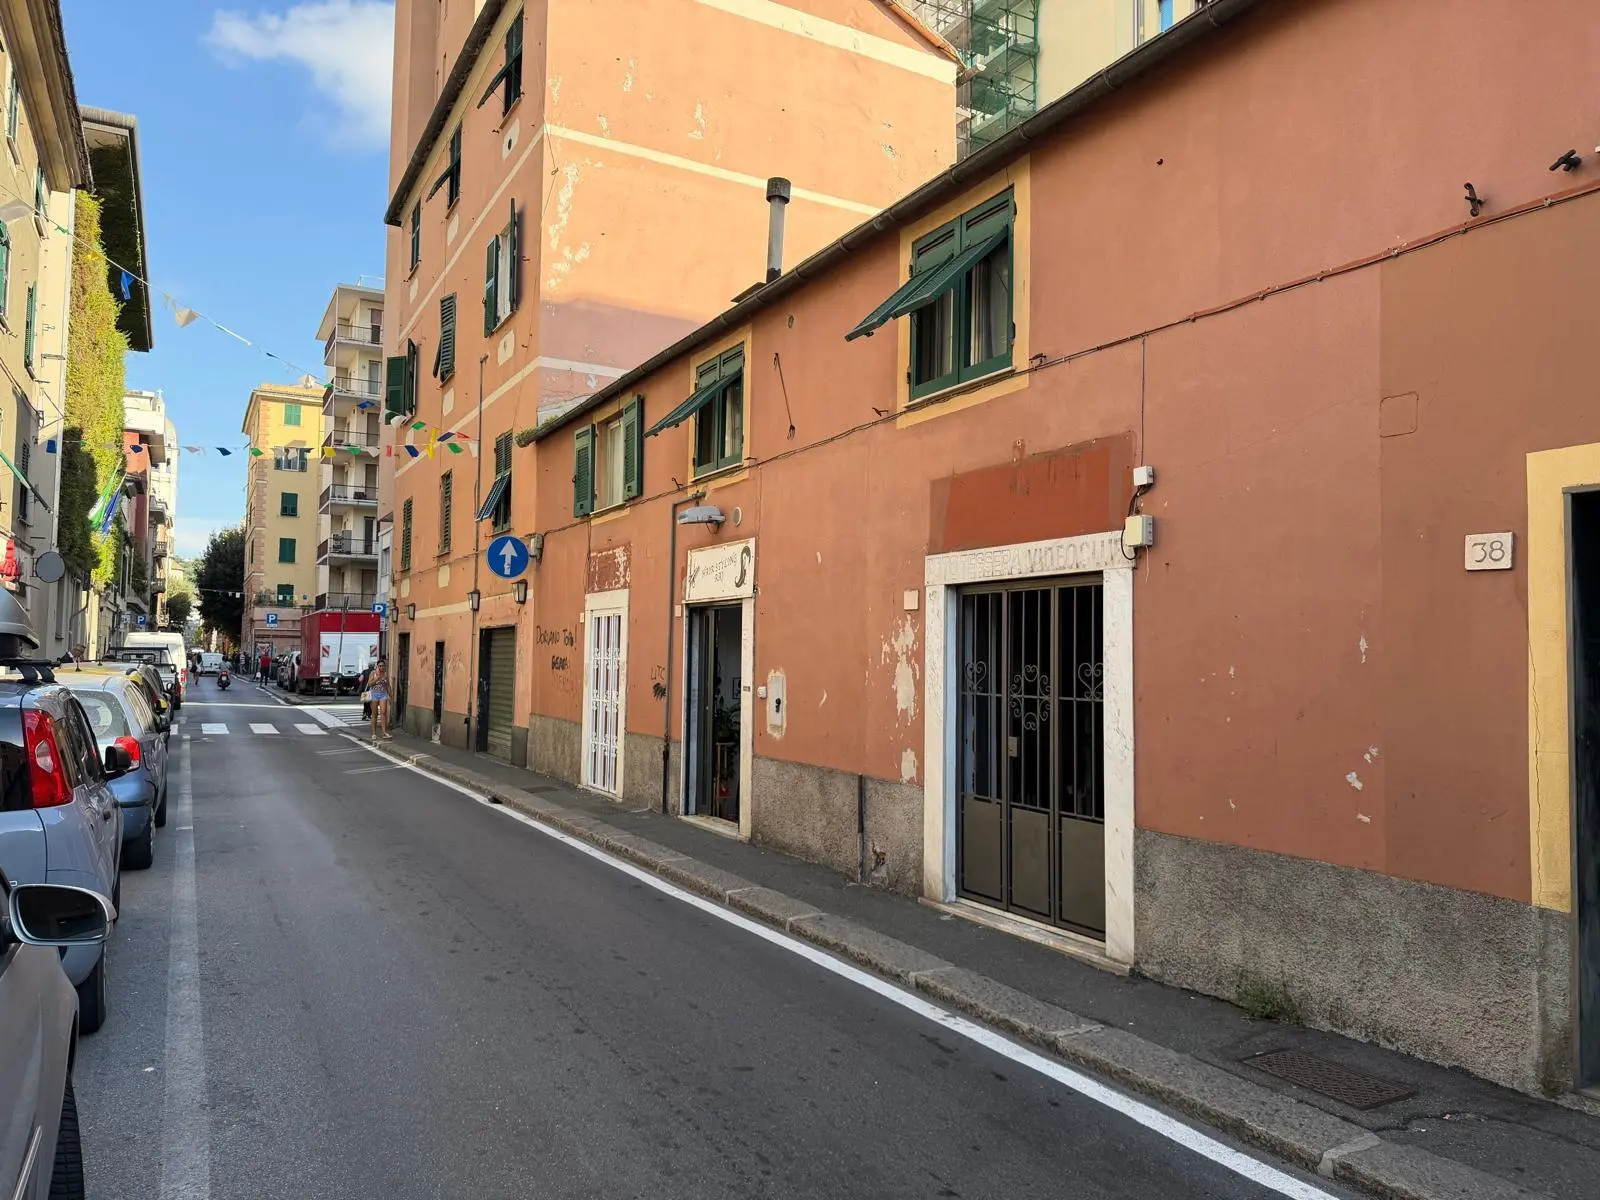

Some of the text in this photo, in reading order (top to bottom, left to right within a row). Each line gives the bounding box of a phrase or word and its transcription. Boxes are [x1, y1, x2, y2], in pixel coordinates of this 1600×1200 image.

[1471, 540, 1506, 563] 38
[137, 615, 145, 624] P
[269, 614, 276, 624] P
